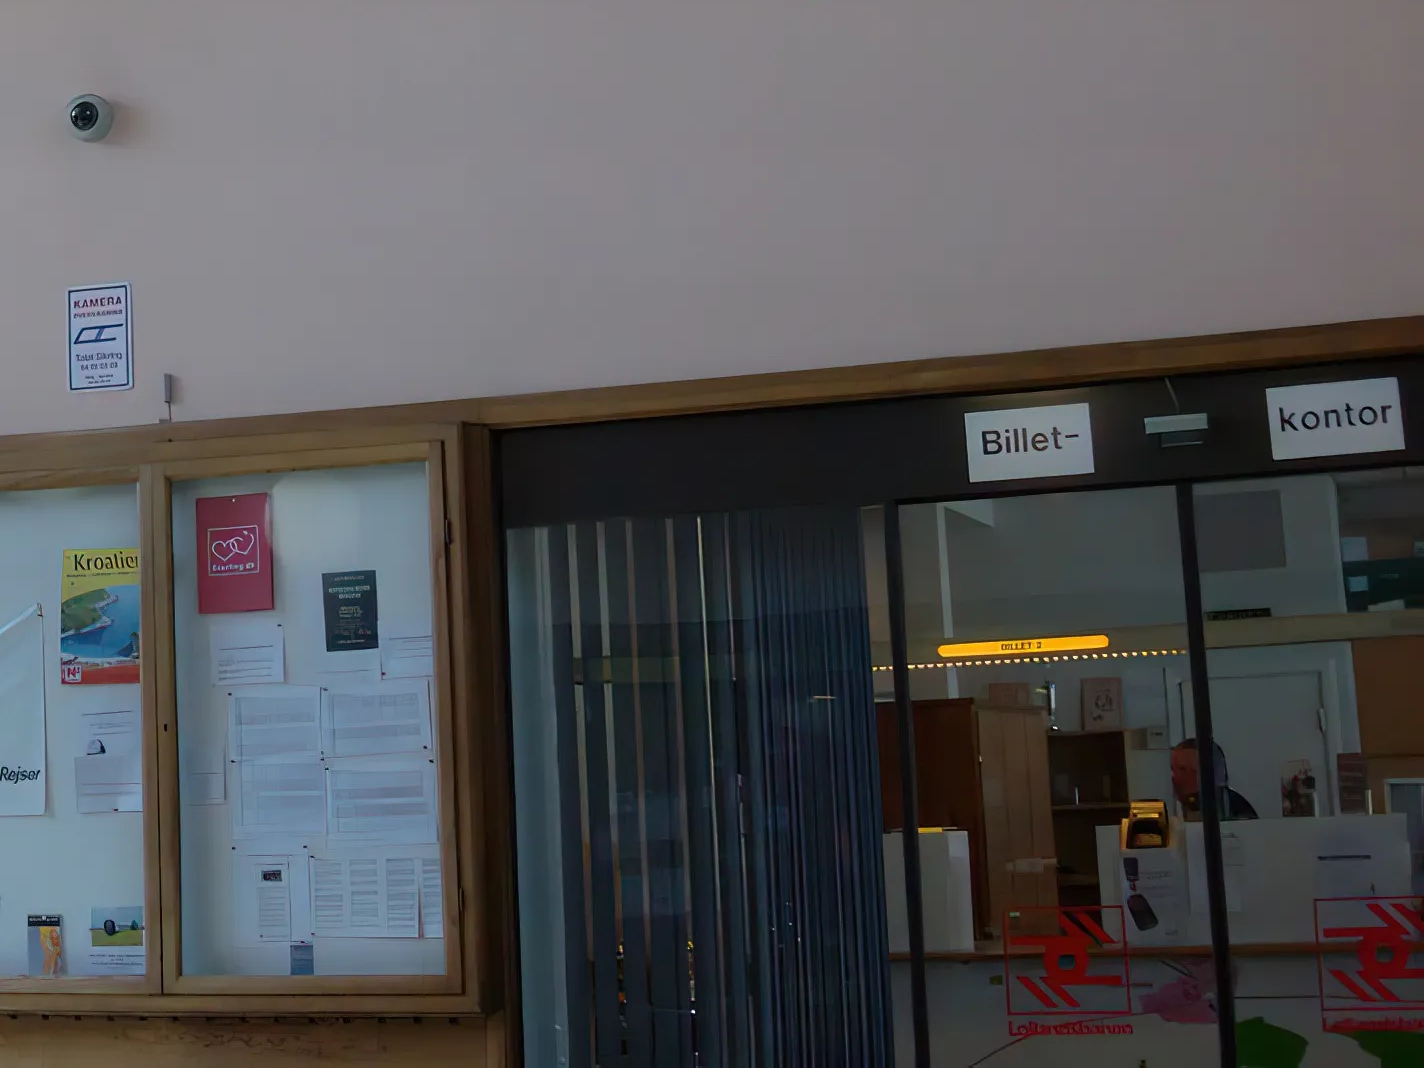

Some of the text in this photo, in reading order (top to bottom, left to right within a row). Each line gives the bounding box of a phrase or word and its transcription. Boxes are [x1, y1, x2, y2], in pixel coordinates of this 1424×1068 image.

[73, 296, 122, 309] KAMERA
[981, 403, 1393, 456] Billet- kontor
[0, 766, 41, 784] Rejser
